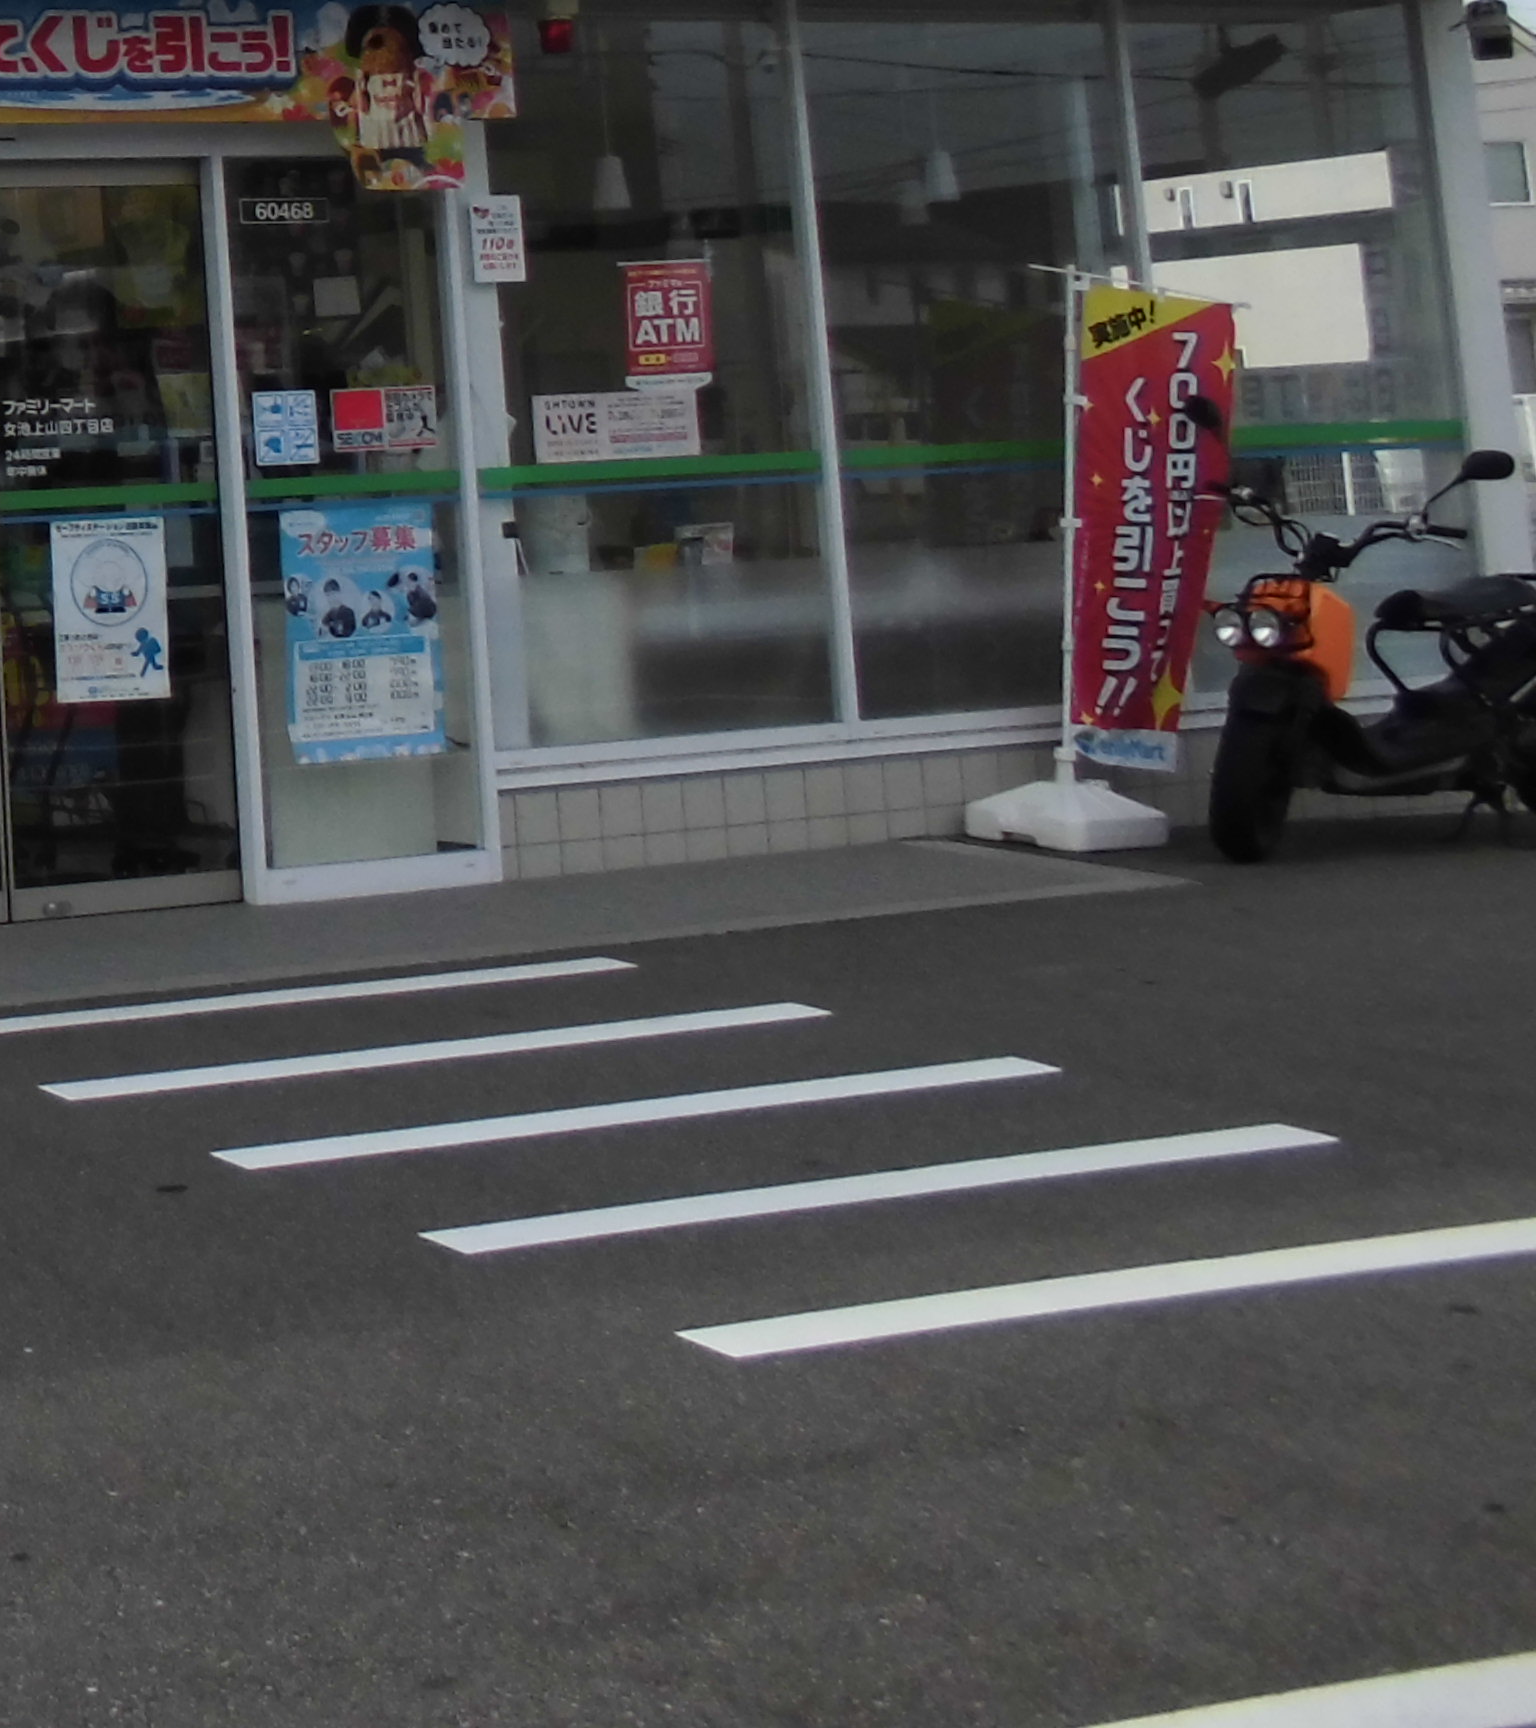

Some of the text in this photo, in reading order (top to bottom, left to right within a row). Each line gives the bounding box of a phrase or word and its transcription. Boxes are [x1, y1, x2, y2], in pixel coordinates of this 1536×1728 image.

[255, 200, 316, 223] 60468
[634, 289, 698, 317] 銀行
[635, 317, 701, 345] ATM
[1088, 300, 1157, 349] 実施中!
[1, 397, 97, 416] ファミリーマート
[544, 413, 598, 436] LIVE
[297, 525, 417, 556] スタッフ募集
